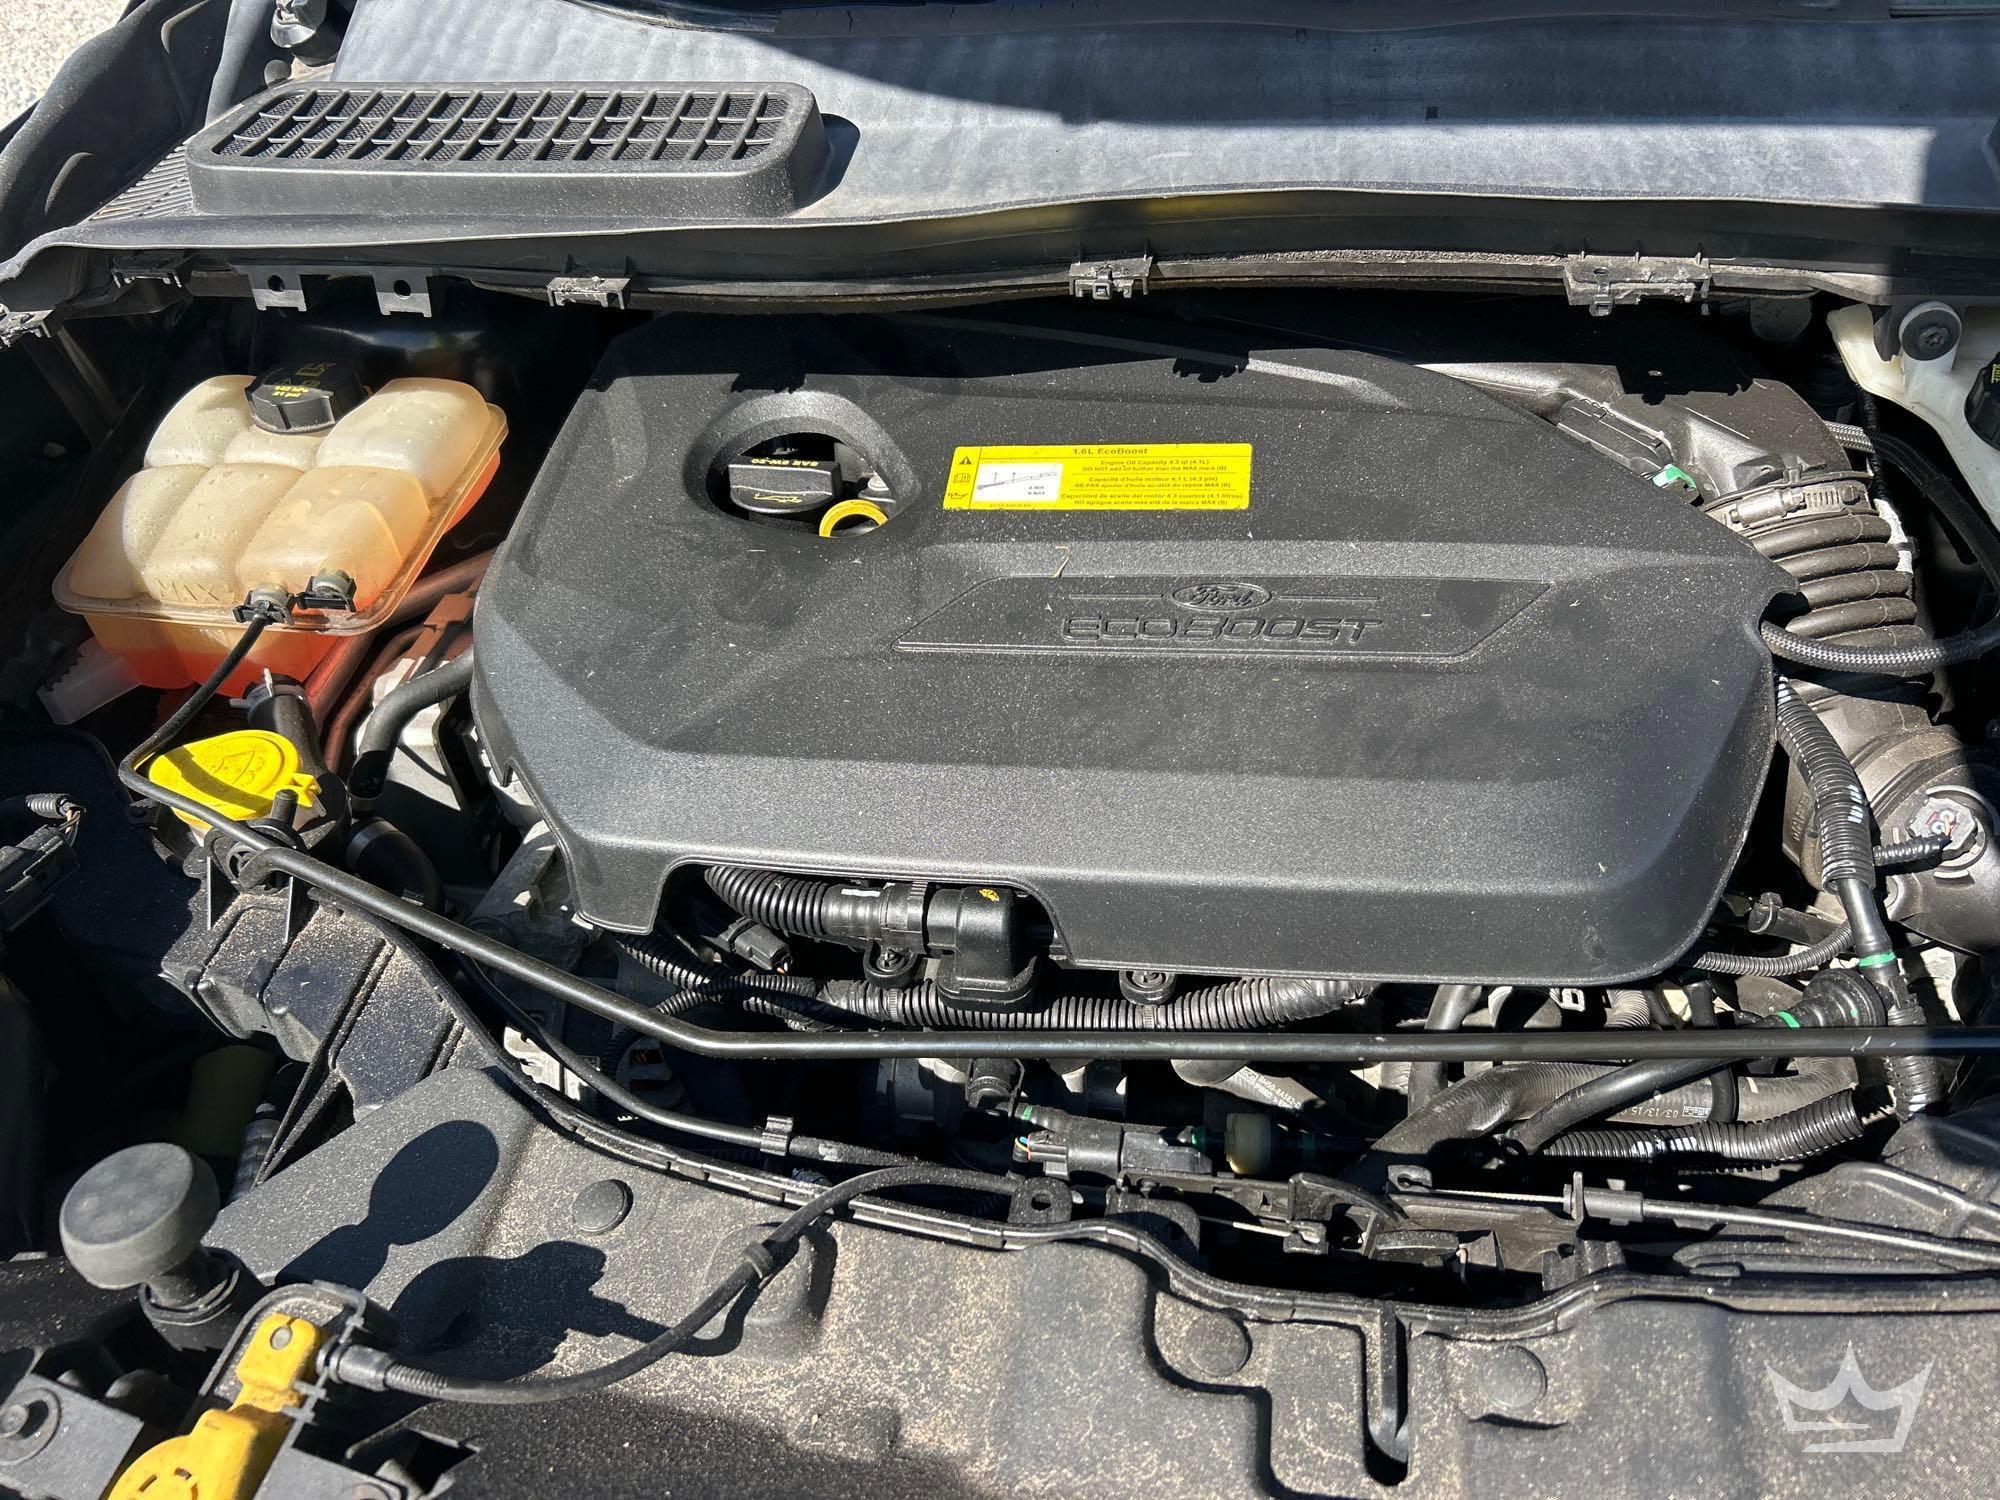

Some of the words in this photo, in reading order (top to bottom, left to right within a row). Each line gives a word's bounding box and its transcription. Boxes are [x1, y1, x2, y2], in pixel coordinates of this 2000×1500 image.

[1098, 447, 1149, 455] EcoBoost
[1190, 585, 1254, 608] Ford
[1062, 615, 1383, 642] ECOBOOST
[1631, 1105, 1679, 1118] 03/13/15
